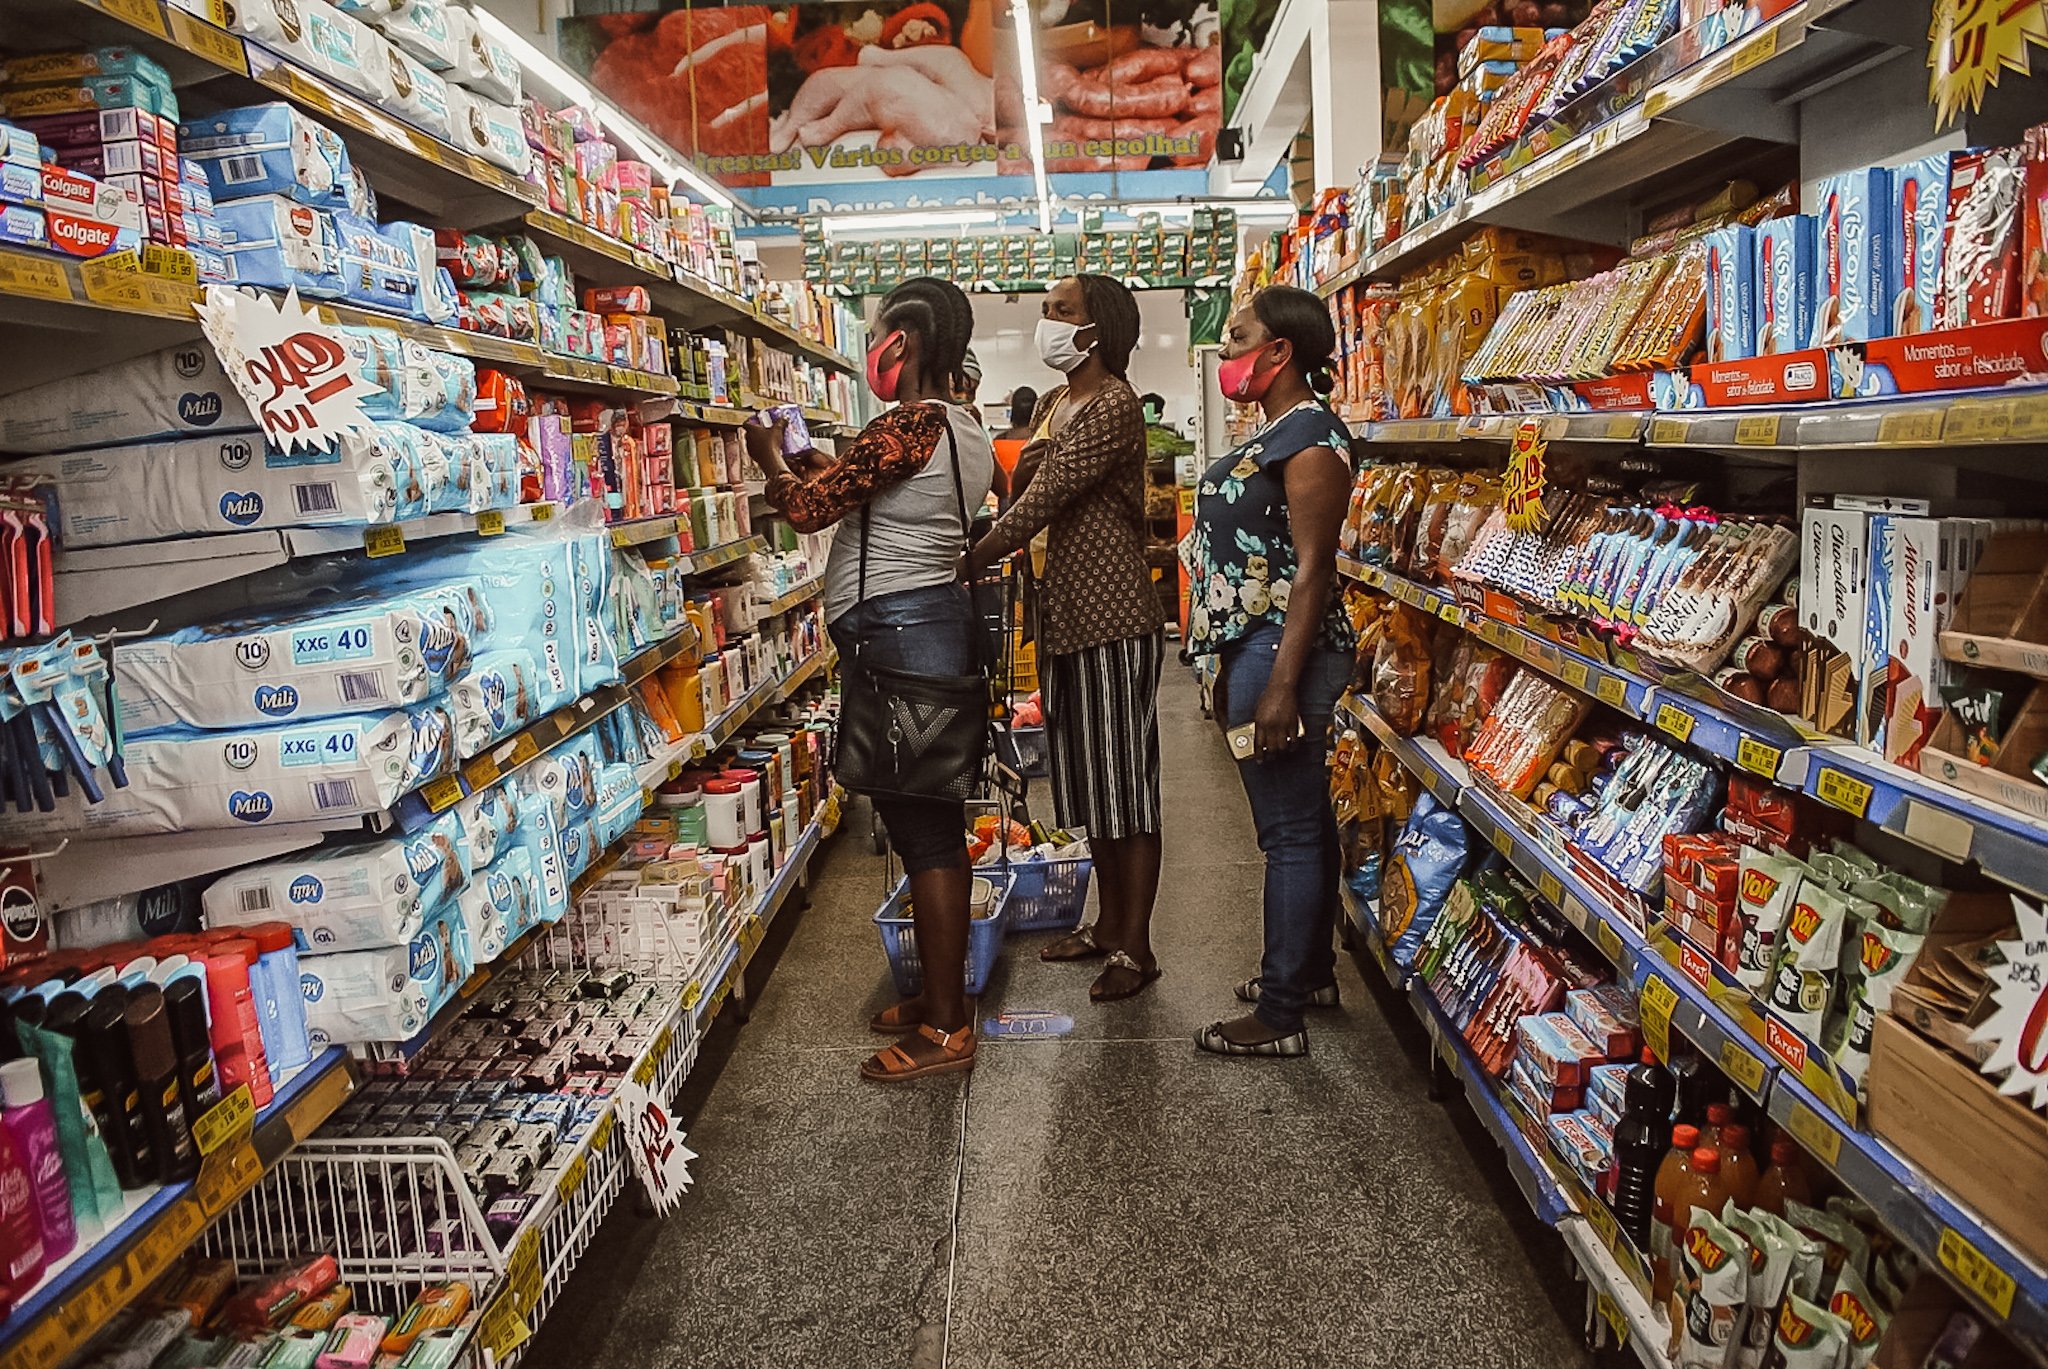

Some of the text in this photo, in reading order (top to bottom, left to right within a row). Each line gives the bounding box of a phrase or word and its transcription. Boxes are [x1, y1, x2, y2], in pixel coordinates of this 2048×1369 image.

[807, 145, 902, 169] Vários
[909, 144, 997, 164] cortes
[1005, 143, 1021, 160] a
[1085, 134, 1198, 158] escolha!
[42, 173, 91, 199] Colgate
[53, 217, 110, 246] Colgate
[1904, 343, 1956, 363] Momentos
[1935, 361, 1962, 378] sabor
[1973, 353, 2027, 374] felicidade
[1711, 370, 1741, 385] Momentos
[184, 397, 218, 421] Mili
[225, 496, 260, 520] Mili
[1831, 523, 1848, 621] Chocolate
[1903, 533, 1918, 639] Morango
[296, 628, 368, 653] XXG 40
[261, 691, 295, 710] Mili
[284, 733, 355, 755] XXG 40
[234, 797, 269, 817] Mili
[411, 851, 438, 875] Mili
[292, 882, 319, 899] Mili
[491, 878, 511, 903] Mili
[144, 894, 178, 924] Mili
[414, 939, 437, 968] Mili
[1683, 945, 1709, 986] Parati
[1768, 1024, 1804, 1070] Parati
